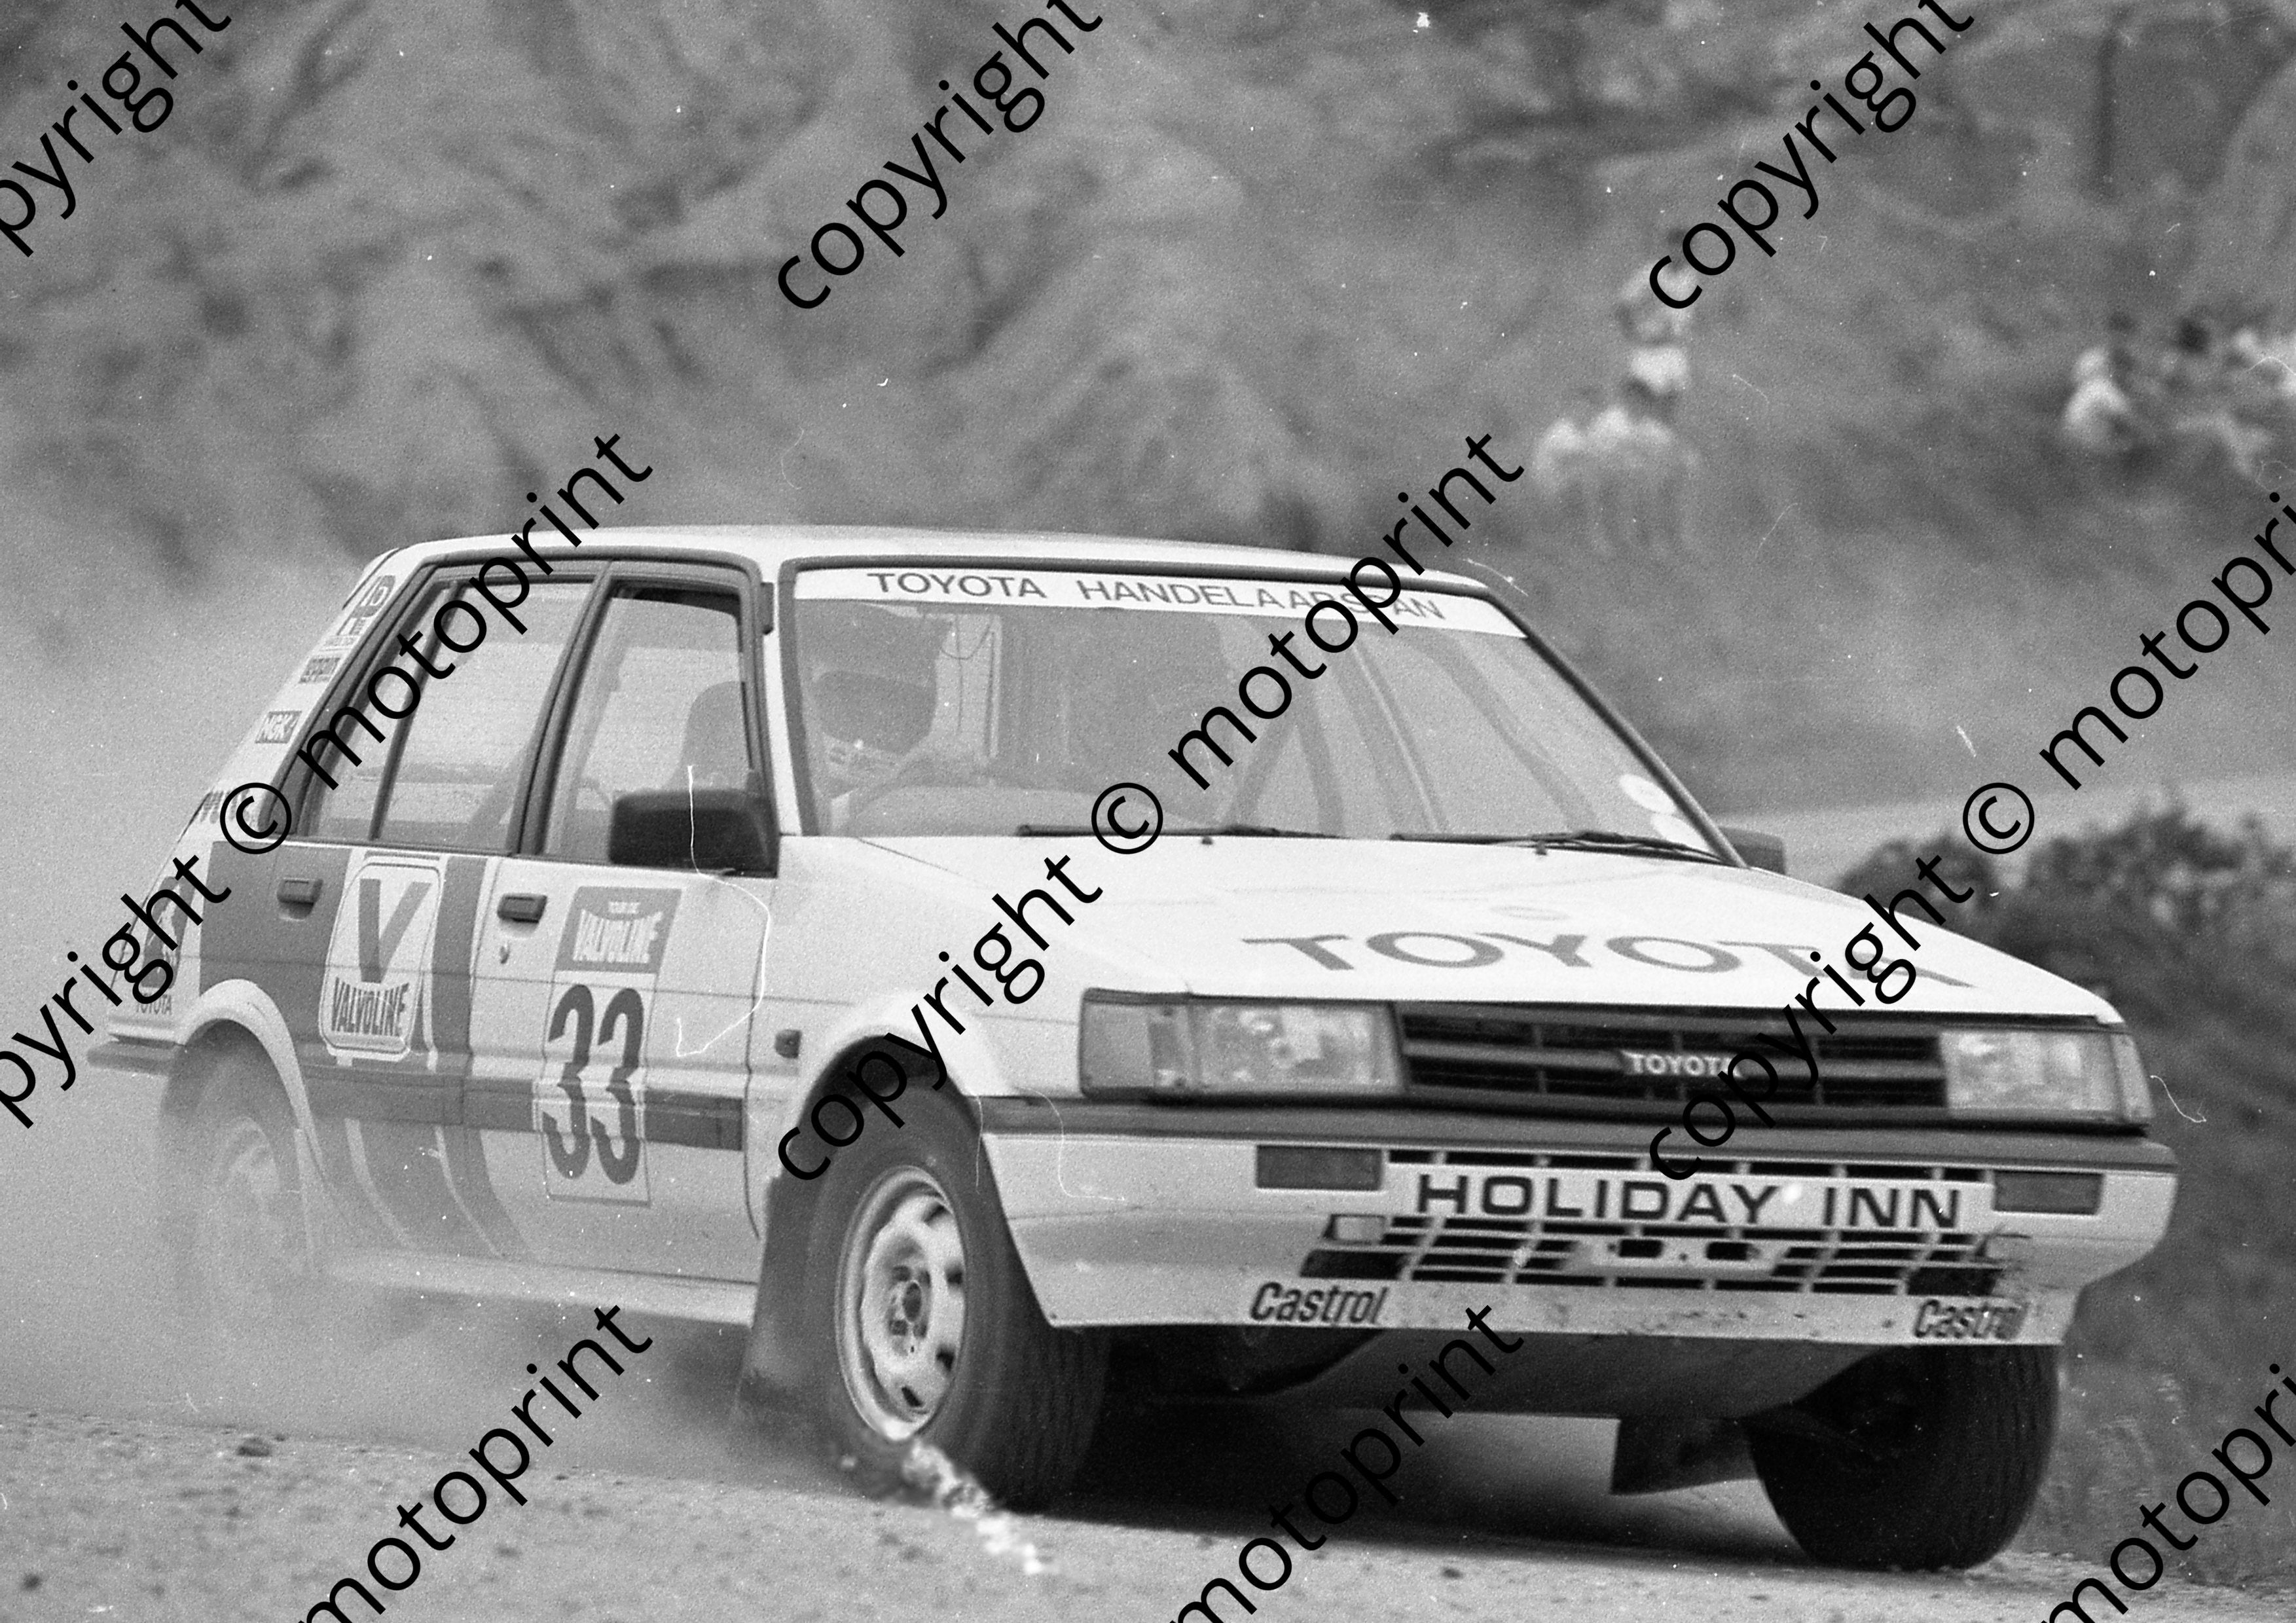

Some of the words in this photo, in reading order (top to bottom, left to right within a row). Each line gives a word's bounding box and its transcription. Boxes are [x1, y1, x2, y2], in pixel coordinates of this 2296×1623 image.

[867, 572, 1047, 598] TOYOTA
[574, 908, 663, 964] VALVOLINE
[1241, 932, 1973, 987] TOYOTA
[331, 977, 409, 1036] VALVOLINE
[541, 984, 644, 1184] 33
[1620, 1049, 1743, 1078] TOYOTA
[1416, 1174, 1779, 1224] HOLIDAY
[1823, 1186, 1959, 1228] INN
[1250, 1281, 1389, 1323] Castrol
[1914, 1298, 2024, 1340] Castro
